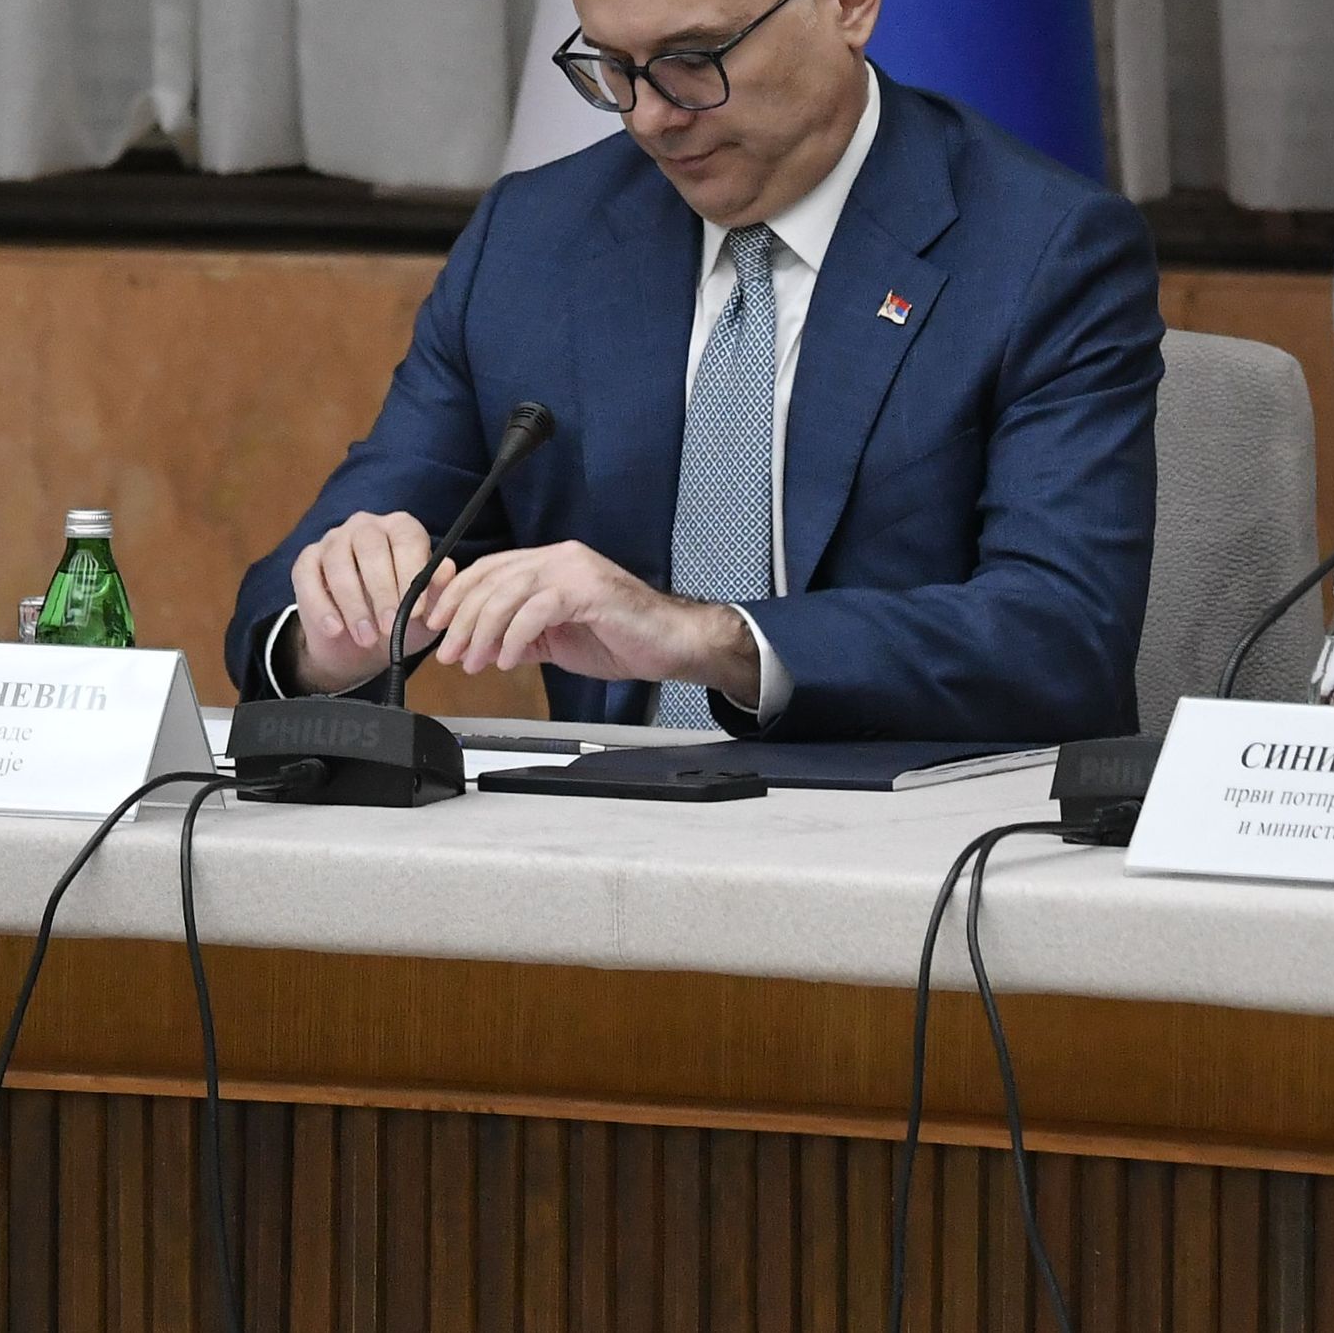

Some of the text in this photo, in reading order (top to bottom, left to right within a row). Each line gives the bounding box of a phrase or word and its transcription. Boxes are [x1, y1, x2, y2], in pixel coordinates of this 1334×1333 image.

[258, 715, 381, 749] PHILIPS
[1223, 785, 1275, 808] први
[1237, 819, 1253, 836] и
